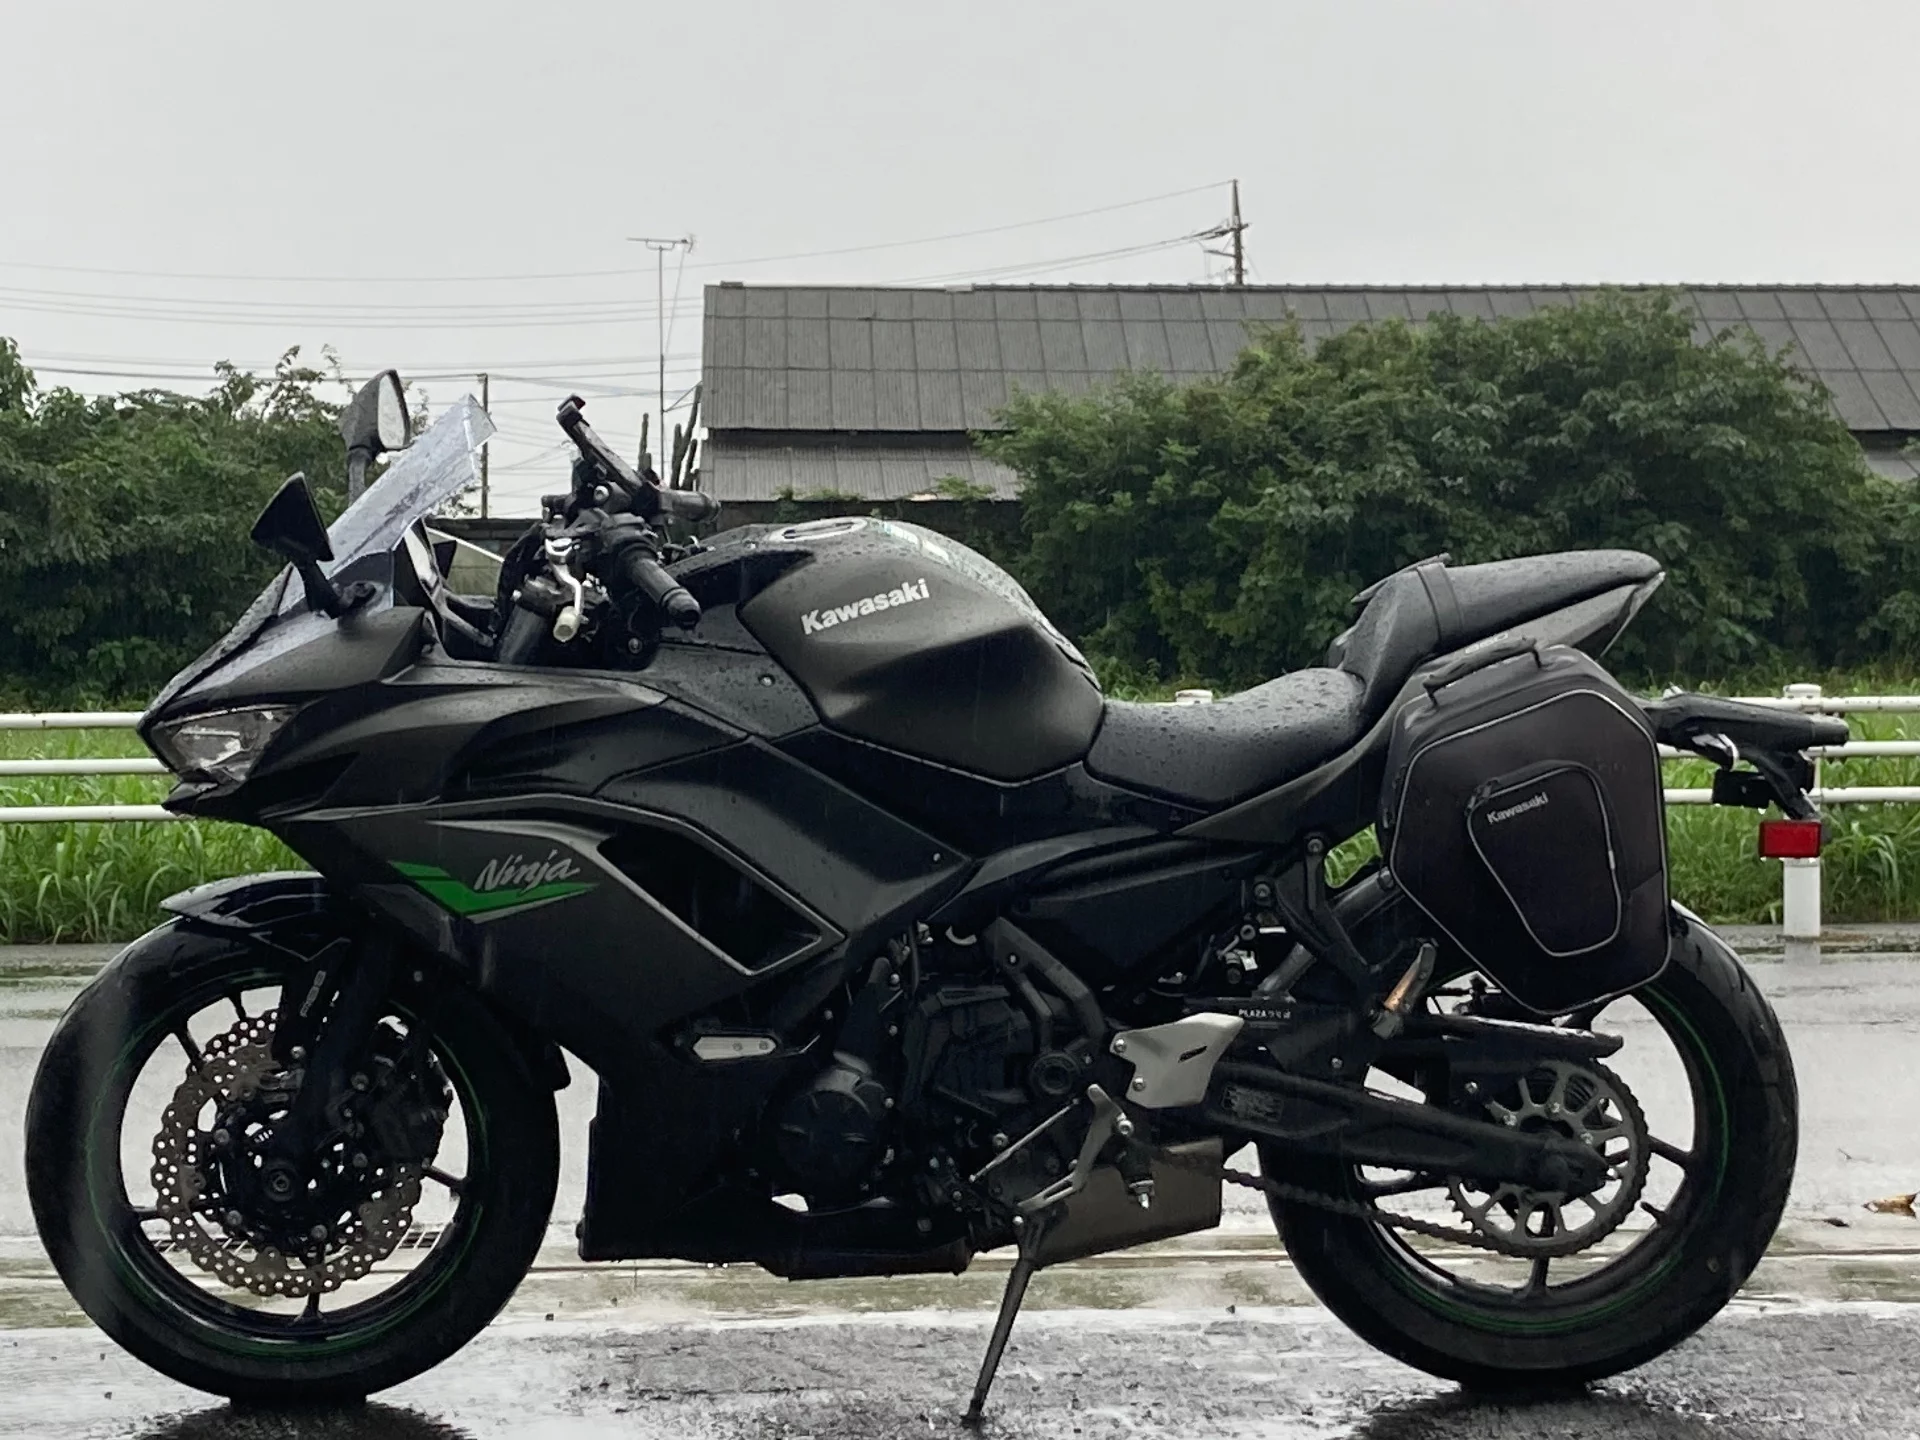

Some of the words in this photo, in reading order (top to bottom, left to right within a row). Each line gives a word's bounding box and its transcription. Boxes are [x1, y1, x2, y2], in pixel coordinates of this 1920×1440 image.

[801, 578, 929, 635] Kawasaki
[1486, 791, 1549, 824] Kawasaki
[473, 849, 580, 894] Ninja
[1238, 1008, 1267, 1018] PLAZA
